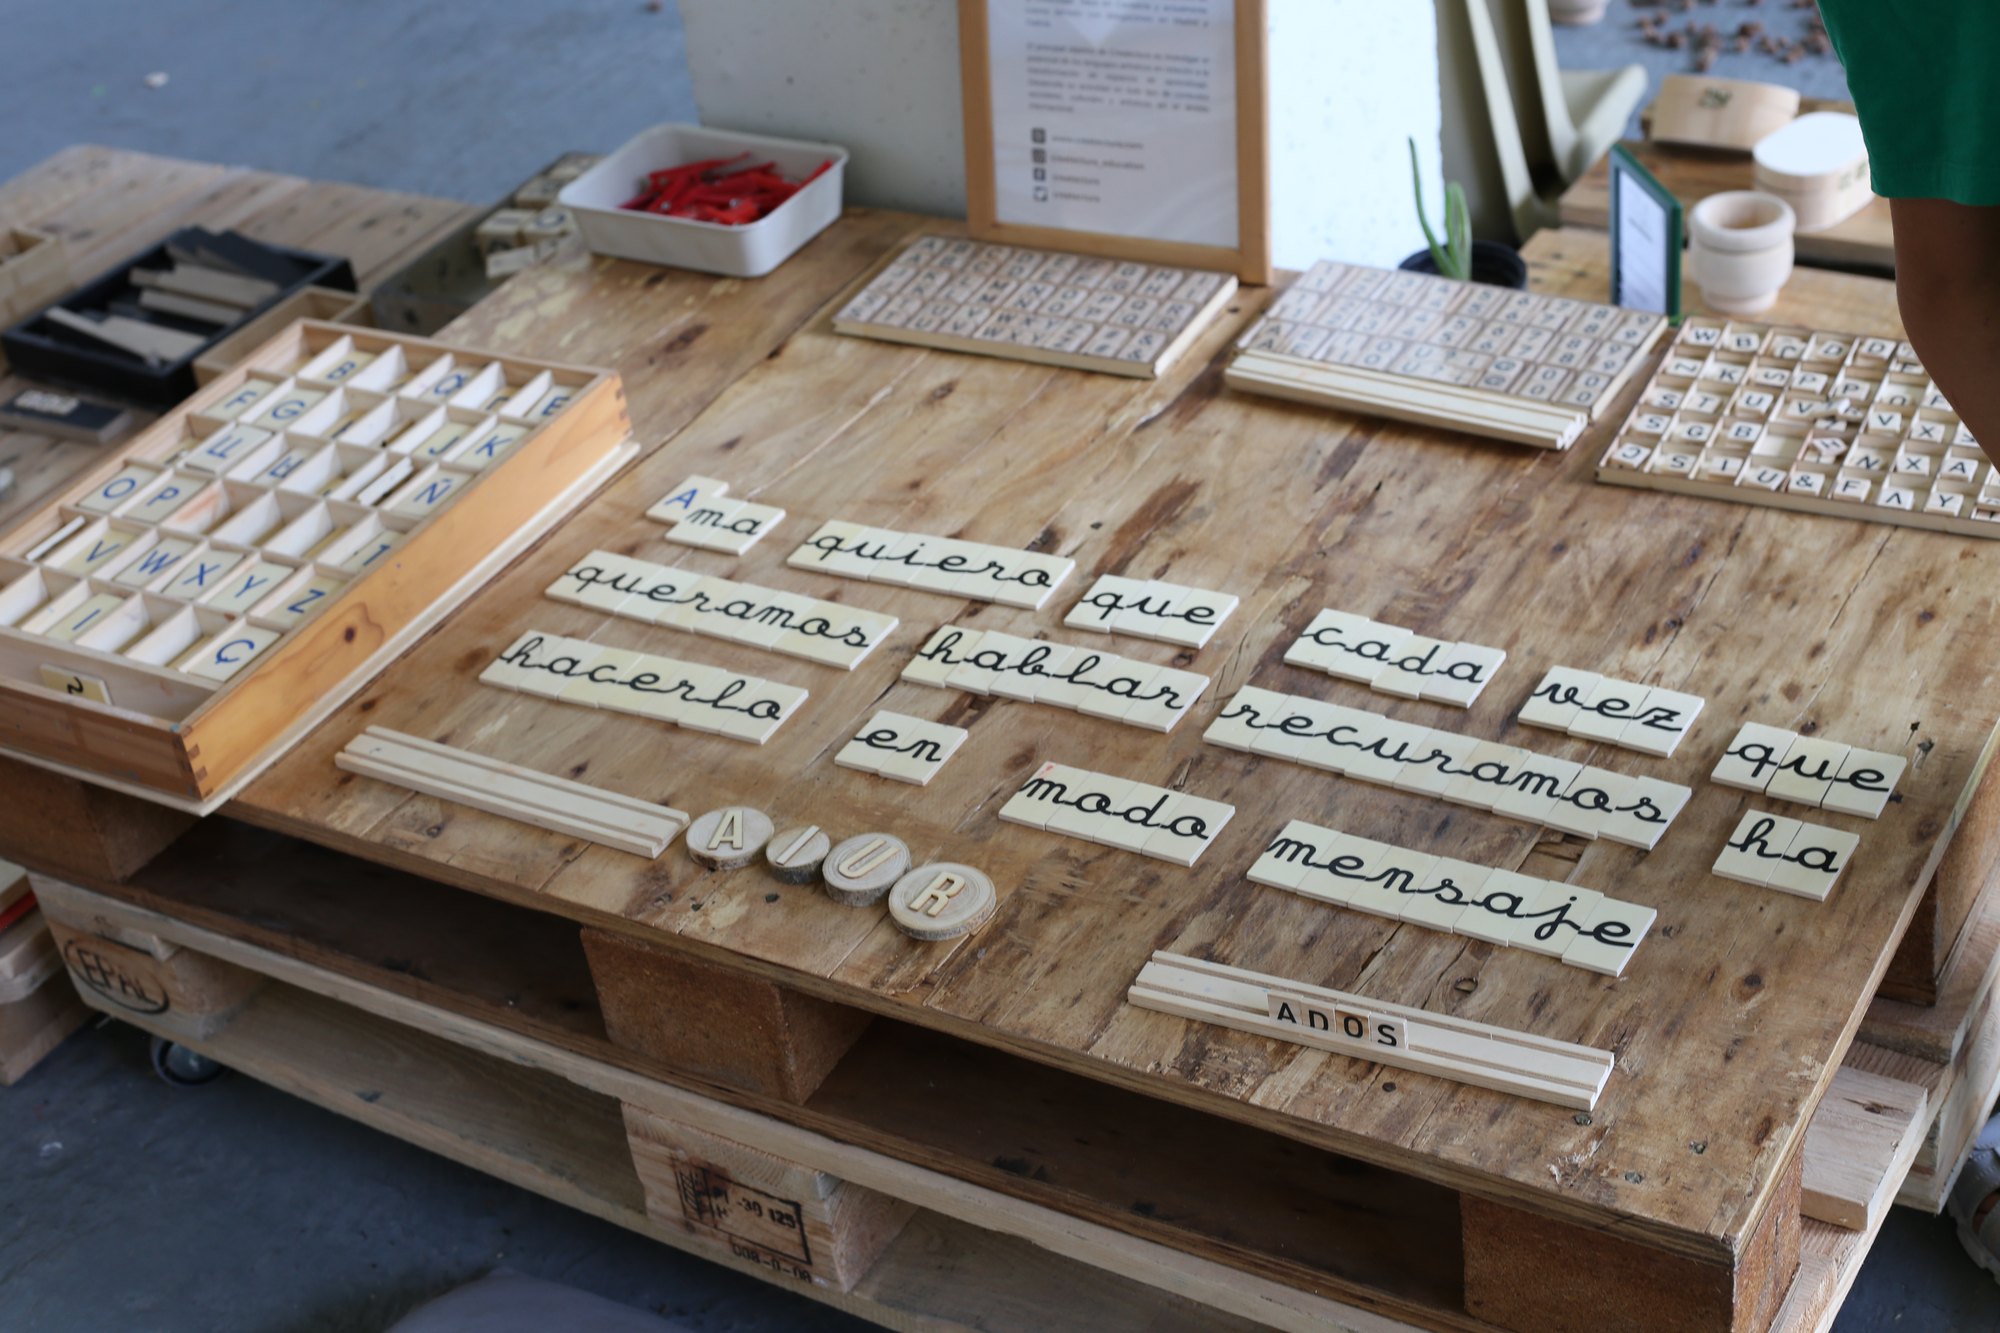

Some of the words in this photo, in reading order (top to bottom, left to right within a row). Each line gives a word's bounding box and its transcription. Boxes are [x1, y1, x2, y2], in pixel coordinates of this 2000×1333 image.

[500, 637, 781, 721] hacerlo
[851, 728, 942, 763] en
[1019, 770, 1210, 841] modo
[1265, 836, 1635, 948] mensaje
[565, 564, 871, 648] queramos
[919, 630, 1184, 710] hablar
[1220, 704, 1668, 824] recuramos
[1727, 818, 1840, 873] ha
[805, 530, 1054, 589] quiero
[1083, 588, 1217, 627] que
[1300, 627, 1484, 684] cada
[1531, 681, 1684, 732] vez
[1725, 743, 1890, 793] que
[1277, 1002, 1398, 1048] ADOS
